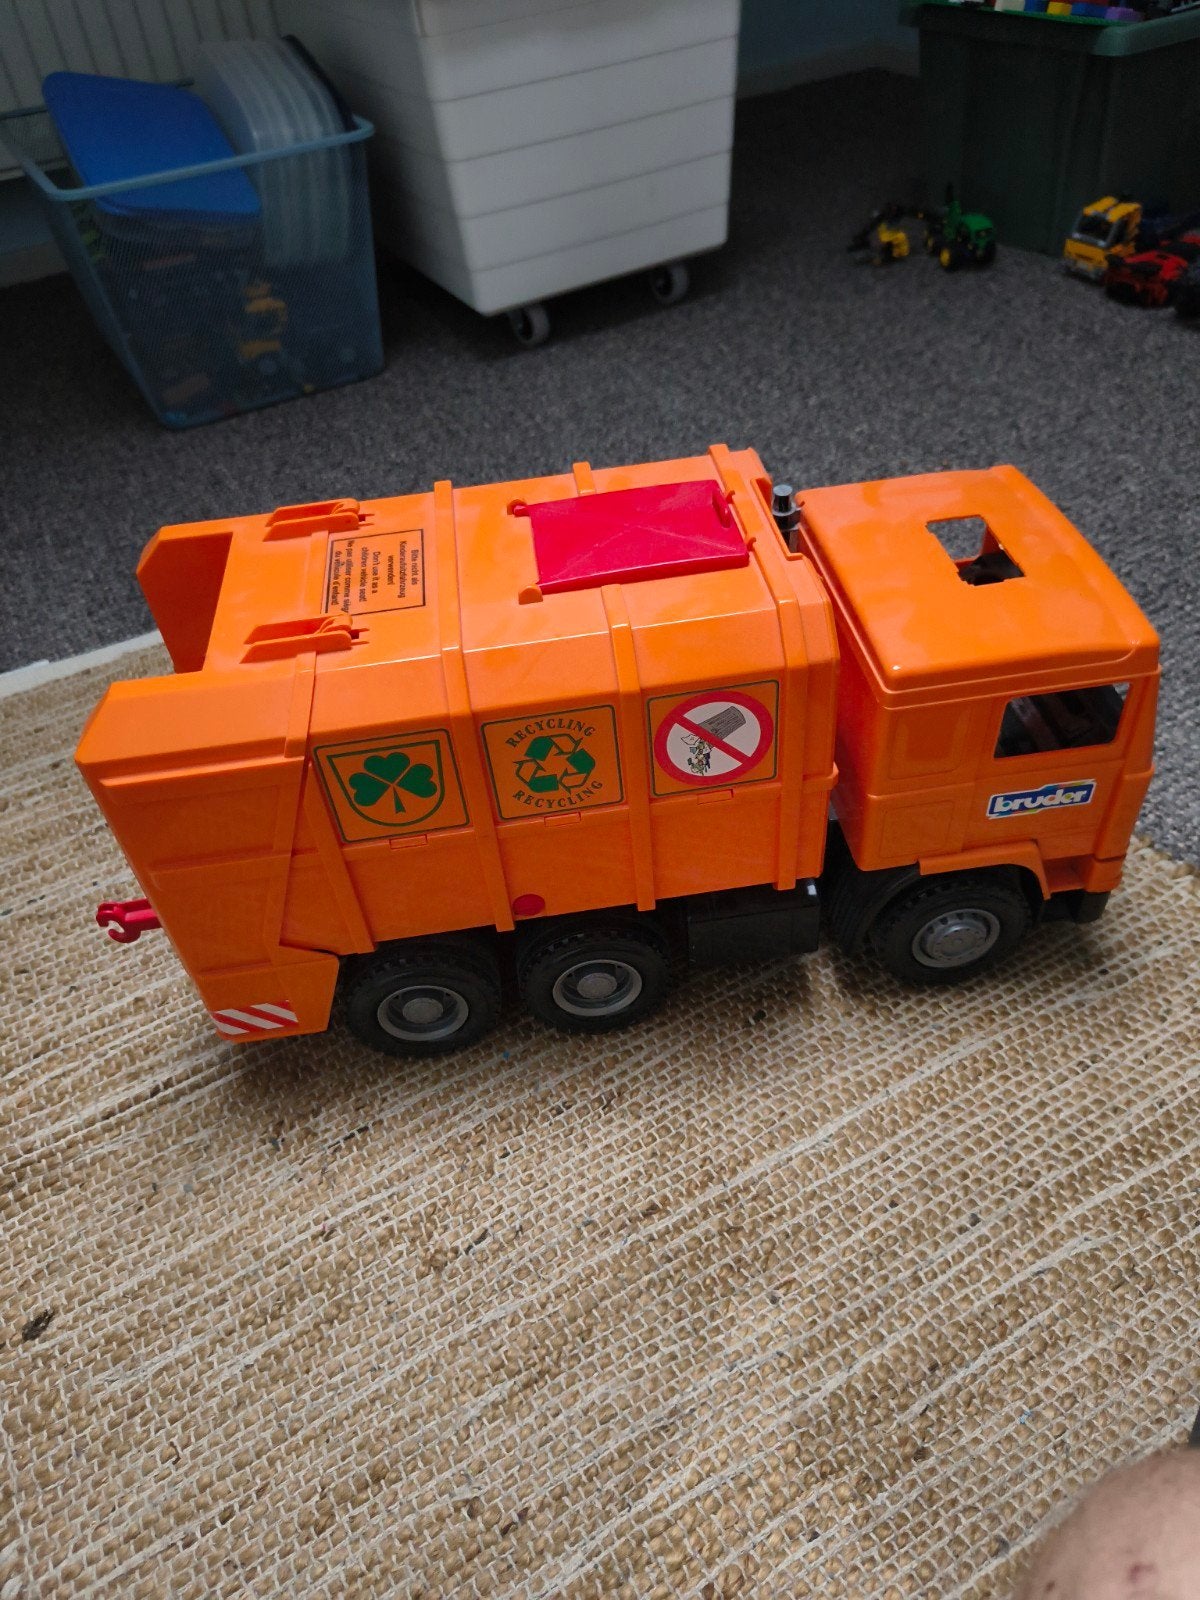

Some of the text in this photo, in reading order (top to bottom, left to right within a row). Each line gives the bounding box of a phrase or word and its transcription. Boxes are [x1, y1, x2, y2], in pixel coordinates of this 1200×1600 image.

[361, 546, 369, 568] children
[373, 551, 381, 565] Don't
[411, 550, 419, 562] Bitte
[345, 558, 353, 576] utiliser
[360, 568, 368, 588] vehicle
[505, 718, 596, 748] RECYCLING
[512, 780, 603, 808] RECYCLING
[994, 788, 1087, 813] bruder
